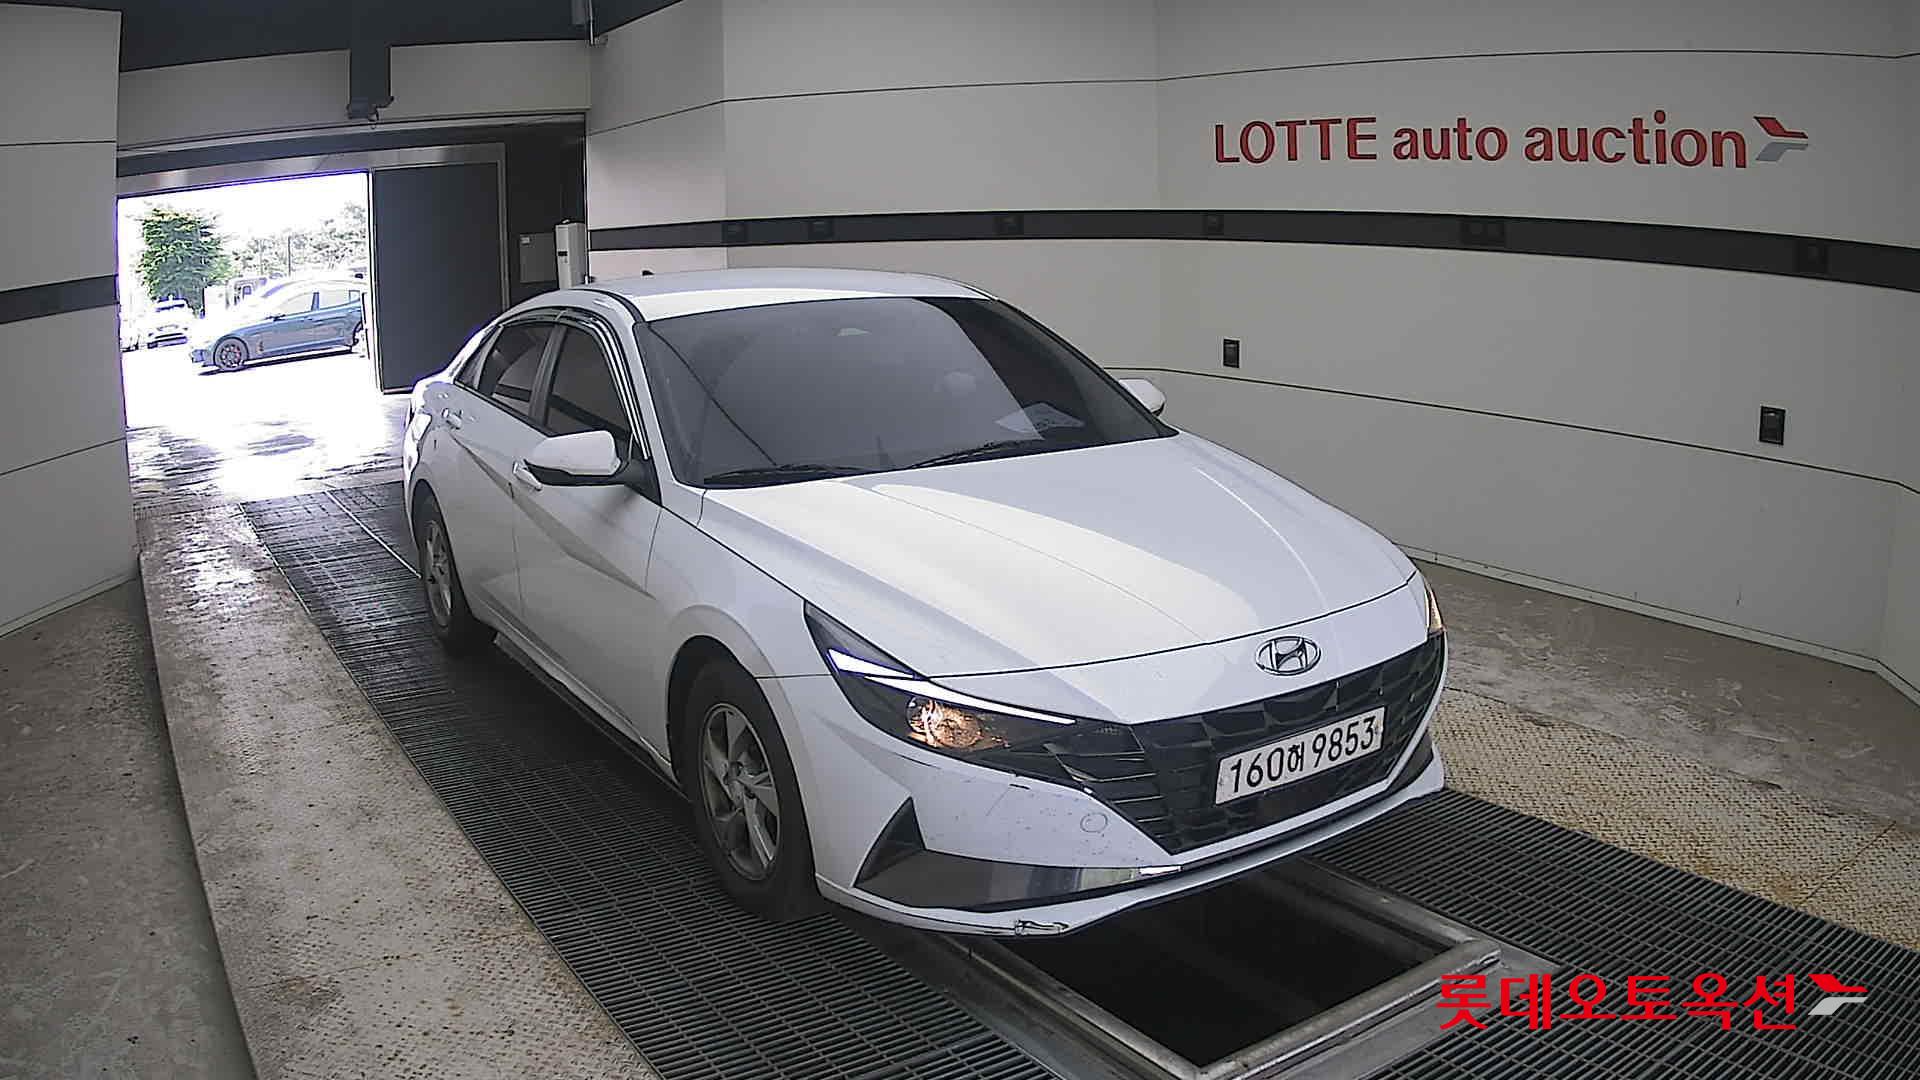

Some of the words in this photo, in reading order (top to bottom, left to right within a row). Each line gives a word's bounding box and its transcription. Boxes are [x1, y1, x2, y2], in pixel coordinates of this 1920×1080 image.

[1215, 117, 1377, 163] LOTTE
[1392, 117, 1508, 162] auto
[1523, 110, 1747, 168] auction
[1230, 741, 1305, 793] 160허
[1311, 715, 1377, 768] 9853
